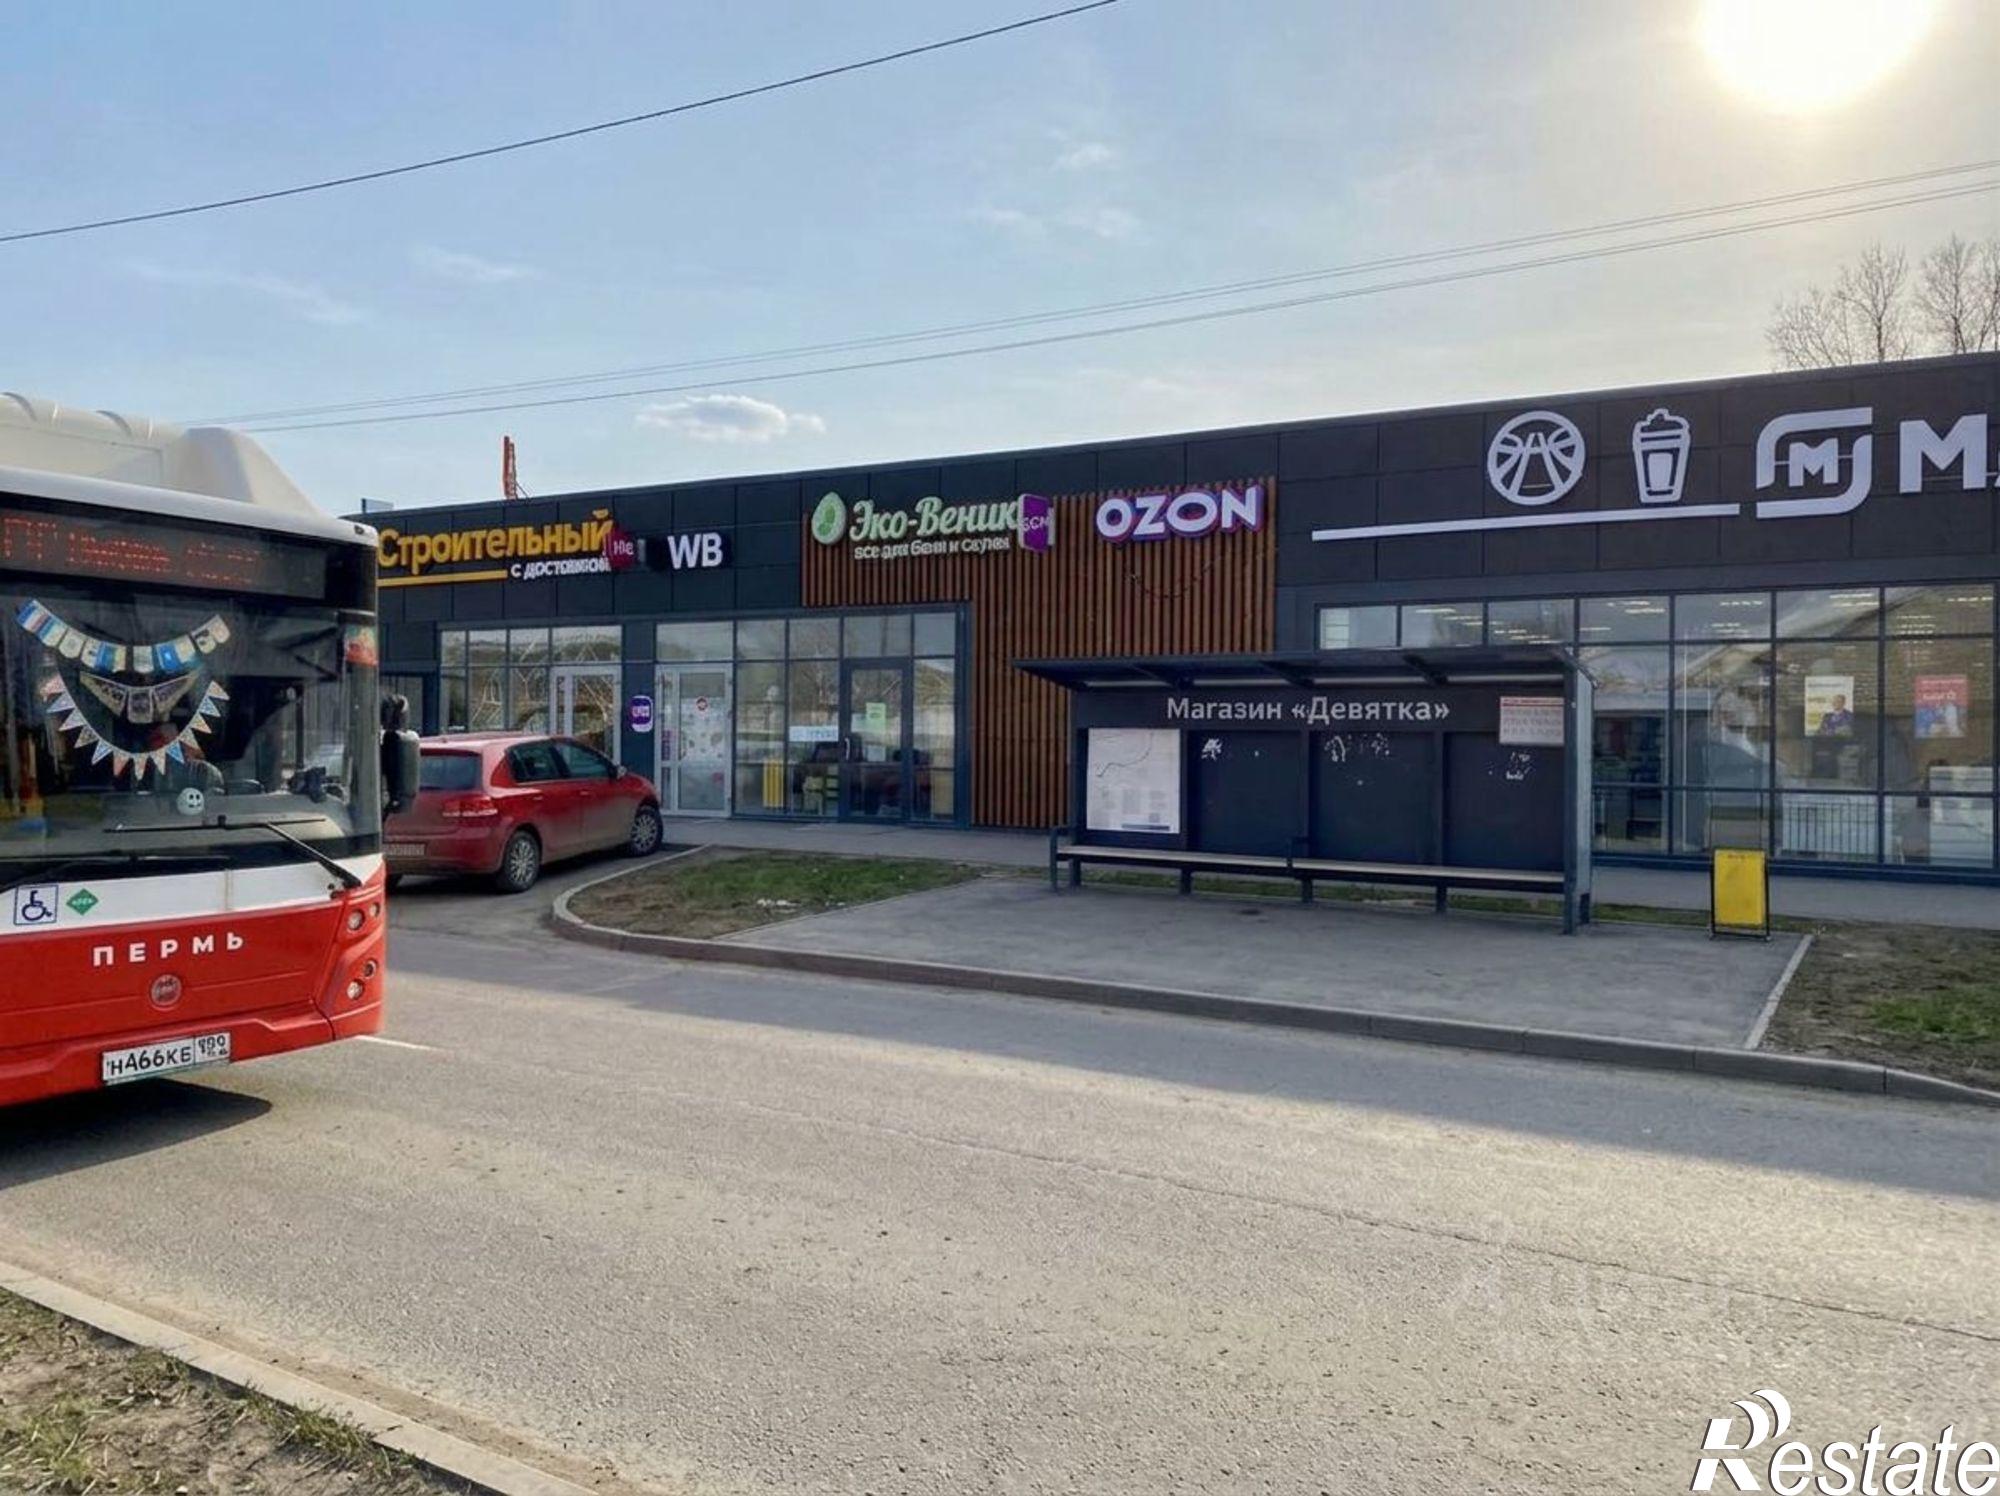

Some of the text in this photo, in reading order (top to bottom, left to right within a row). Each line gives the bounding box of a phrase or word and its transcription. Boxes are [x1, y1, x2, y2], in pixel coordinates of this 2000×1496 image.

[1096, 485, 1263, 542] OZON
[378, 509, 613, 575] Строительный
[667, 532, 723, 570] WB
[1167, 696, 1450, 725] Магазин «Девятка»
[93, 932, 242, 966] ПЕРМЬ
